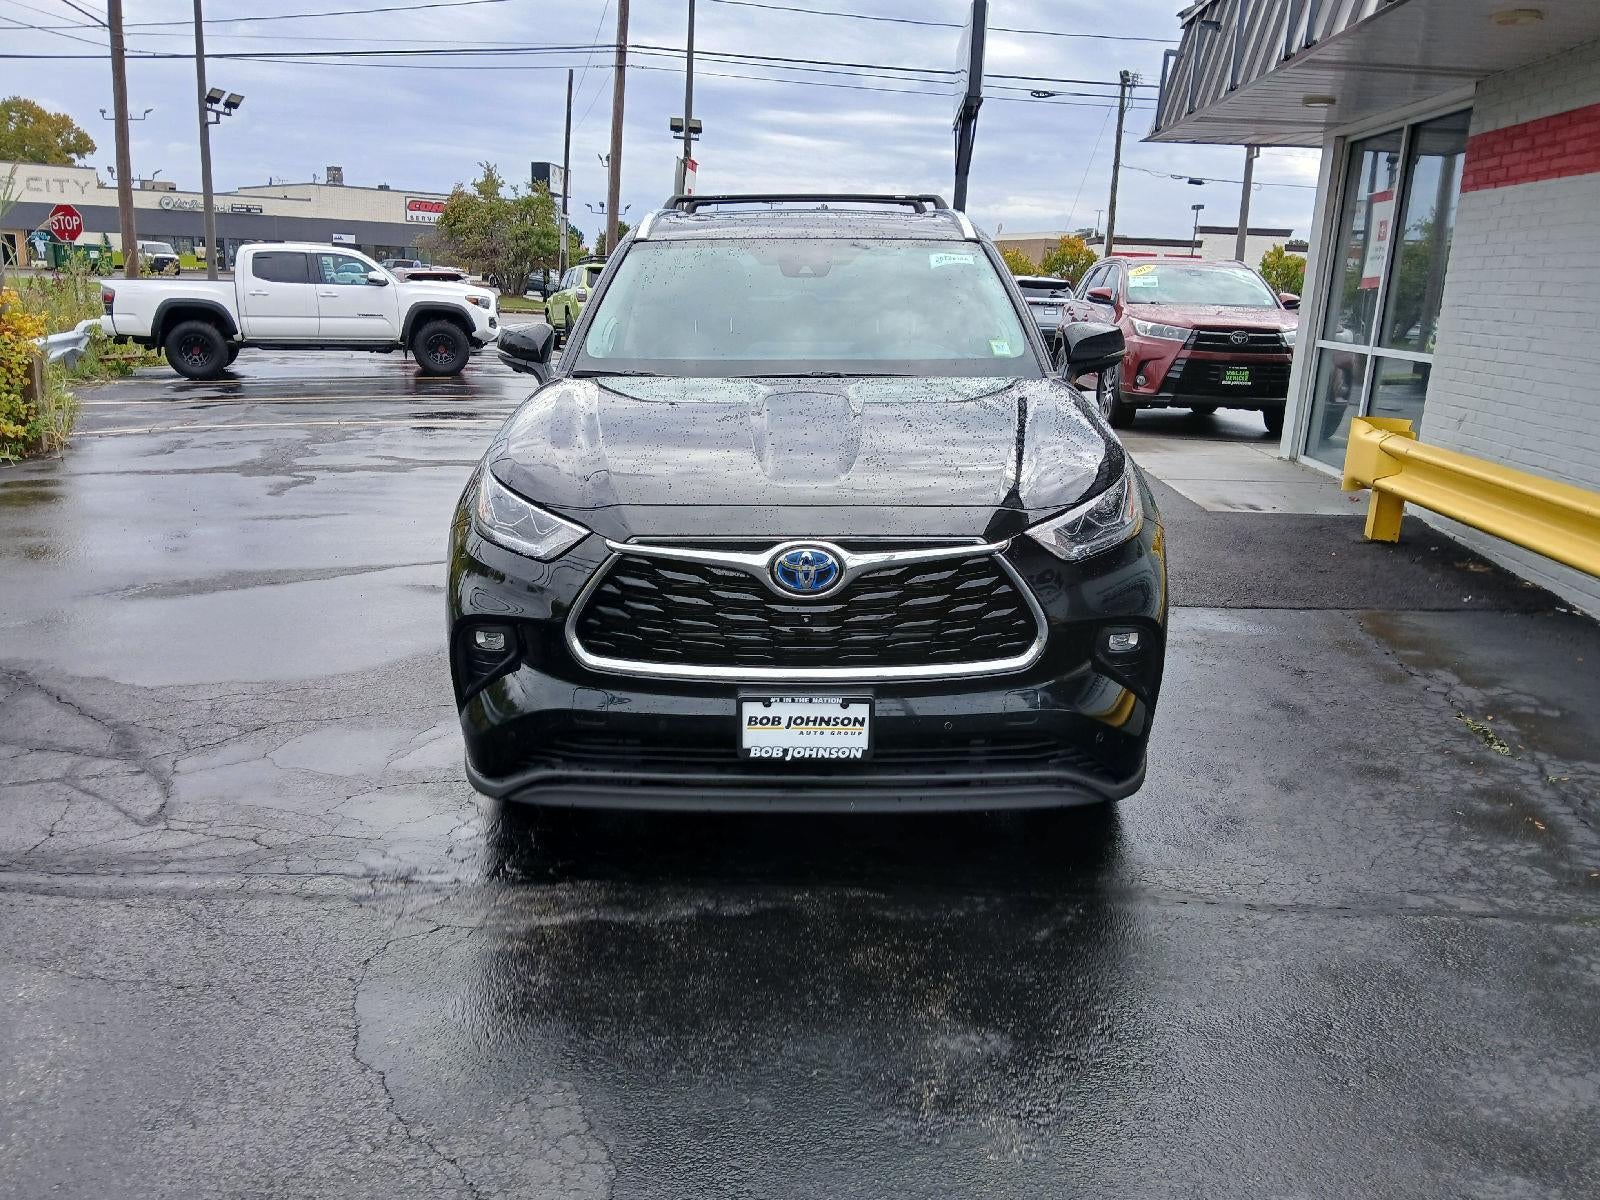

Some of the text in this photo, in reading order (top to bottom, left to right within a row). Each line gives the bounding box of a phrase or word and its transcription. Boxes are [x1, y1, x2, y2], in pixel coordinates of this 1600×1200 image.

[25, 176, 90, 195] CITY
[51, 215, 80, 230] STOP
[747, 715, 866, 730] BOB JOHNSON
[749, 746, 864, 761] BOB JOHNSON
